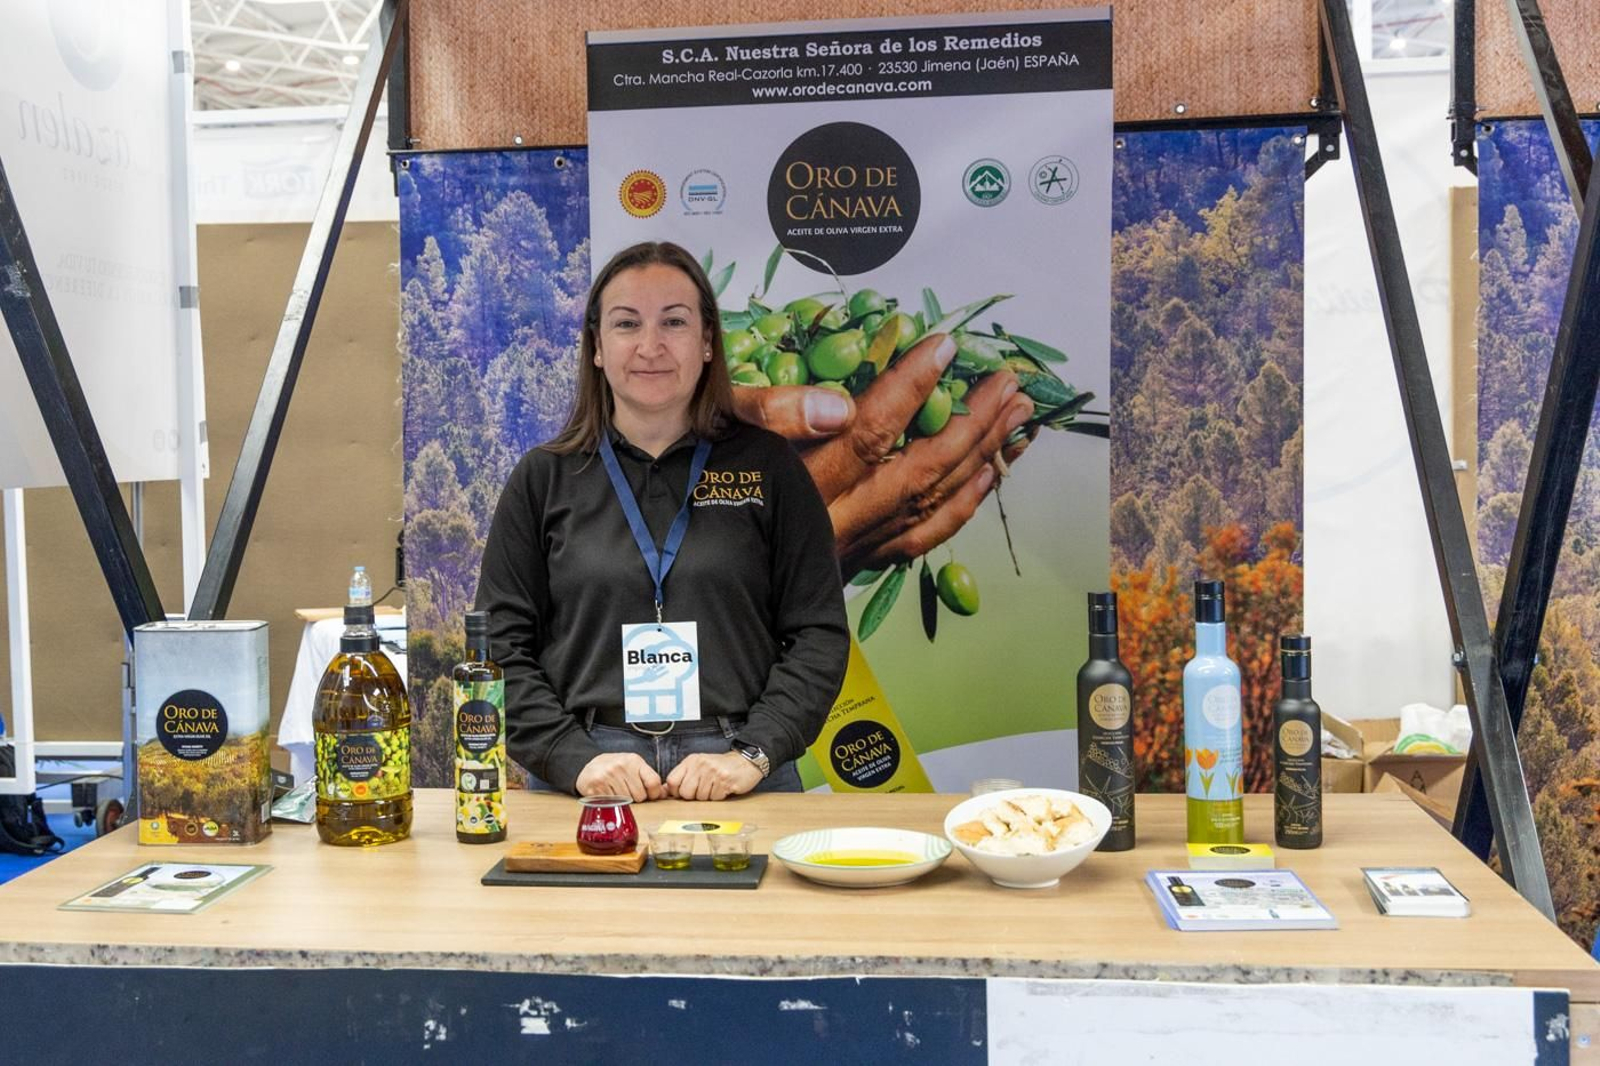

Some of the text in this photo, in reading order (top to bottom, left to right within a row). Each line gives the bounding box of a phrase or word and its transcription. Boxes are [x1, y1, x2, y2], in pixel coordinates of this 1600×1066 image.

[662, 32, 1043, 64] S.C.A. Nuestra Señora de los Remedios
[613, 50, 1080, 87] Ctra. Mancha Real-Cazorla km.17.400 23530 Jimena (Jaén) ESPAÑA
[752, 79, 933, 98] www.orodecanava.com
[785, 161, 898, 190] ORO DE
[785, 192, 904, 221] CÁNAVA
[787, 225, 903, 236] ACEITE DE OLIVA VIRGEN EXTRA
[738, 471, 762, 484] DE
[627, 649, 693, 665] Blanca
[164, 705, 218, 719] ORO DE
[459, 712, 496, 723] ORO DE
[164, 720, 220, 733] CÁNAVA
[341, 745, 364, 755] ORO
[834, 730, 885, 759] ORO DE
[841, 743, 893, 772] CÁNAVA
